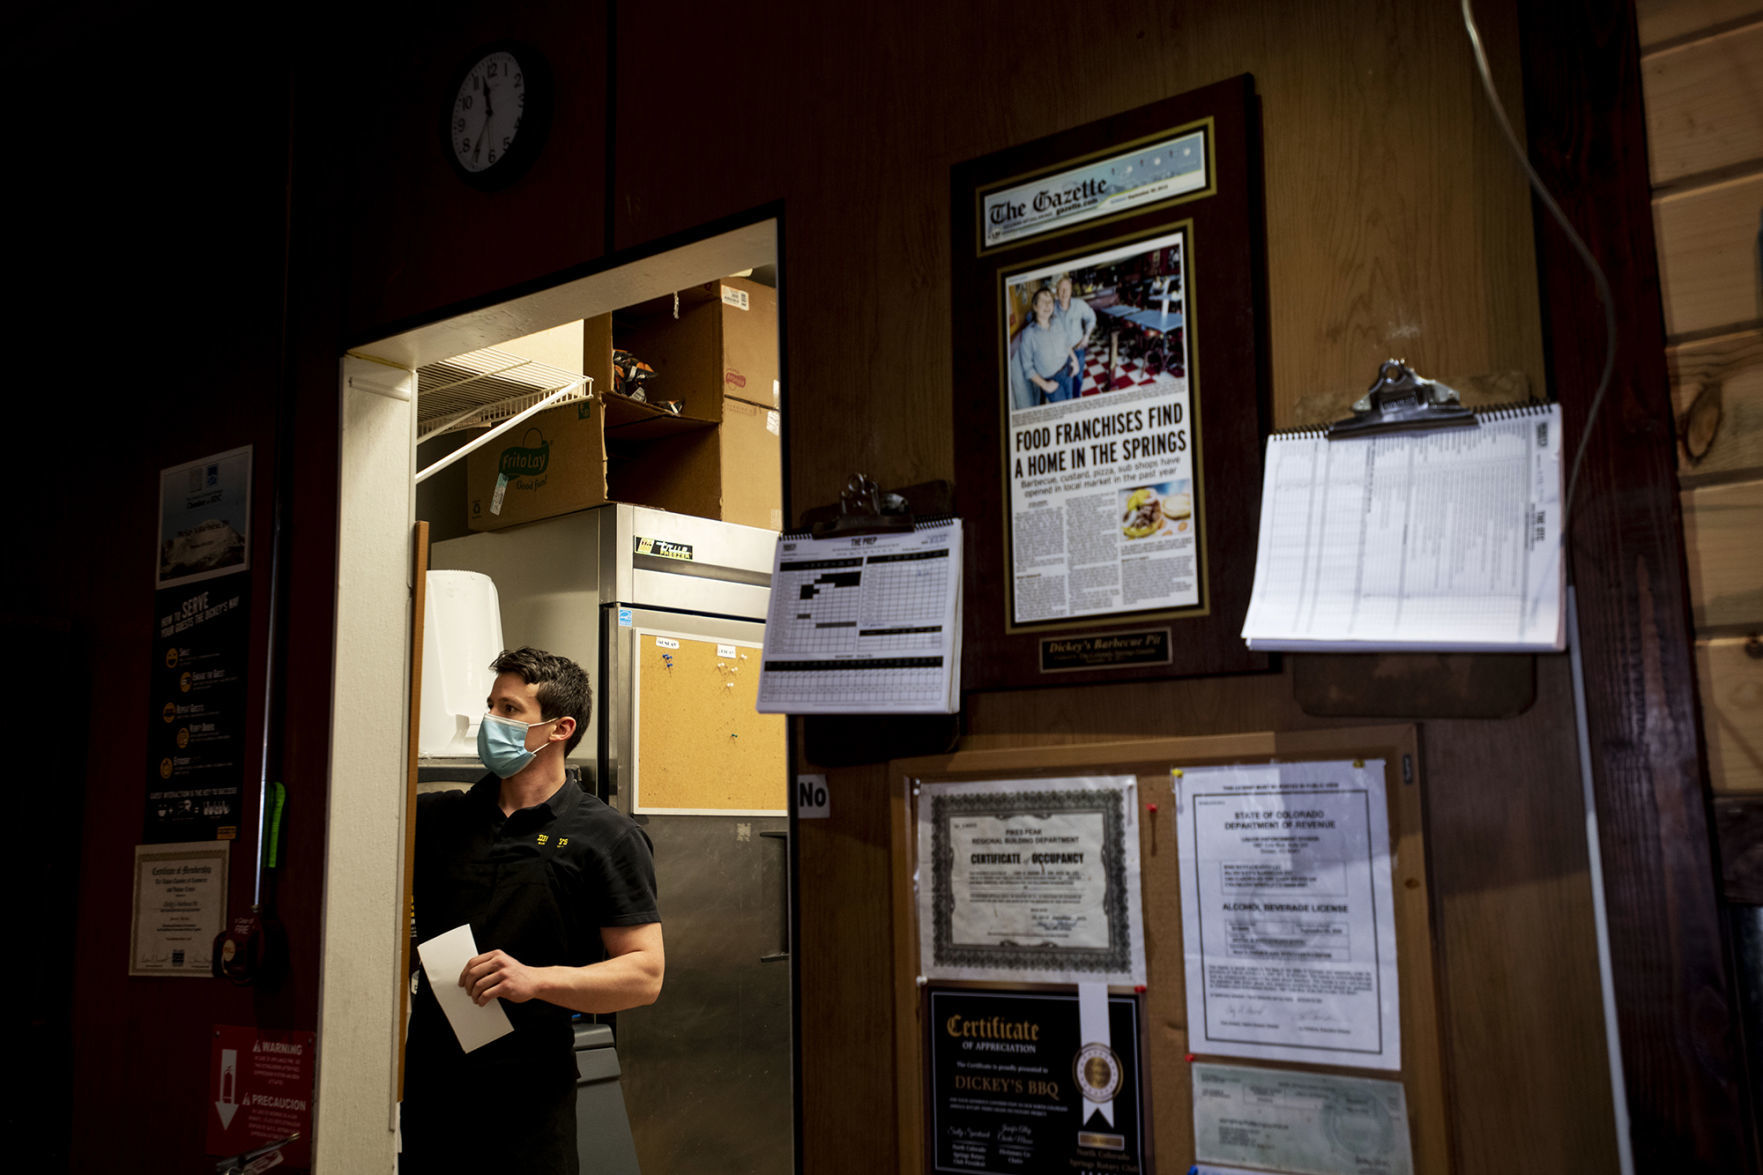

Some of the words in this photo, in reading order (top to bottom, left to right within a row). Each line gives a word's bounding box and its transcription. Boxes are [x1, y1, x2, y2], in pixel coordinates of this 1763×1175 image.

[488, 63, 498, 78] 12
[514, 73, 522, 88] 2
[462, 96, 473, 111] 10
[458, 118, 466, 132] 9
[463, 137, 471, 152] 8
[503, 137, 511, 151] 5
[488, 149, 496, 164] 6
[989, 201, 1026, 225] The
[1033, 178, 1108, 212] Gazette
[1016, 427, 1051, 452] FOOD
[1056, 410, 1143, 445] FRANCHISES
[1148, 402, 1183, 429] FIND
[1014, 458, 1024, 479] A
[1028, 450, 1067, 476] HOME
[1071, 447, 1086, 469] IN
[1091, 442, 1118, 466] THE
[1123, 430, 1187, 461] SPRINGS
[1060, 470, 1091, 482] custard,
[1118, 463, 1132, 473] sub
[1135, 459, 1158, 471] shops
[1160, 456, 1181, 466] have
[1024, 486, 1053, 498] opened
[1055, 485, 1062, 493] in
[1063, 481, 1082, 491] local
[1084, 476, 1112, 488] market
[1114, 475, 1121, 483] in
[1123, 472, 1136, 481] the
[1138, 469, 1156, 481] past
[1159, 467, 1177, 478] year
[800, 782, 826, 807] No
[1235, 811, 1260, 819] STATE
[1263, 811, 1274, 819] OF
[1276, 810, 1324, 819] COLORADO
[1224, 822, 1279, 830] DEPARTMENT
[1295, 821, 1336, 829] REVENUE
[1035, 836, 1079, 844] DEPARTMENT
[971, 853, 1021, 864] CERTIFICATE
[1032, 853, 1084, 864] OCCUPANCY
[1222, 903, 1261, 912] ALCOHOL
[1263, 904, 1310, 913] BEVERAGE
[1311, 904, 1348, 913] LICENSE
[946, 1013, 1040, 1041] Certificate
[262, 1041, 303, 1056] WARNING
[962, 1041, 974, 1050] OF
[975, 1041, 1037, 1054] APPRECIATION
[1043, 1066, 1049, 1074] to
[954, 1074, 1024, 1094] DICKEY'S
[1028, 1079, 1061, 1101] BBQ
[252, 1094, 306, 1111] PRECAUCION
